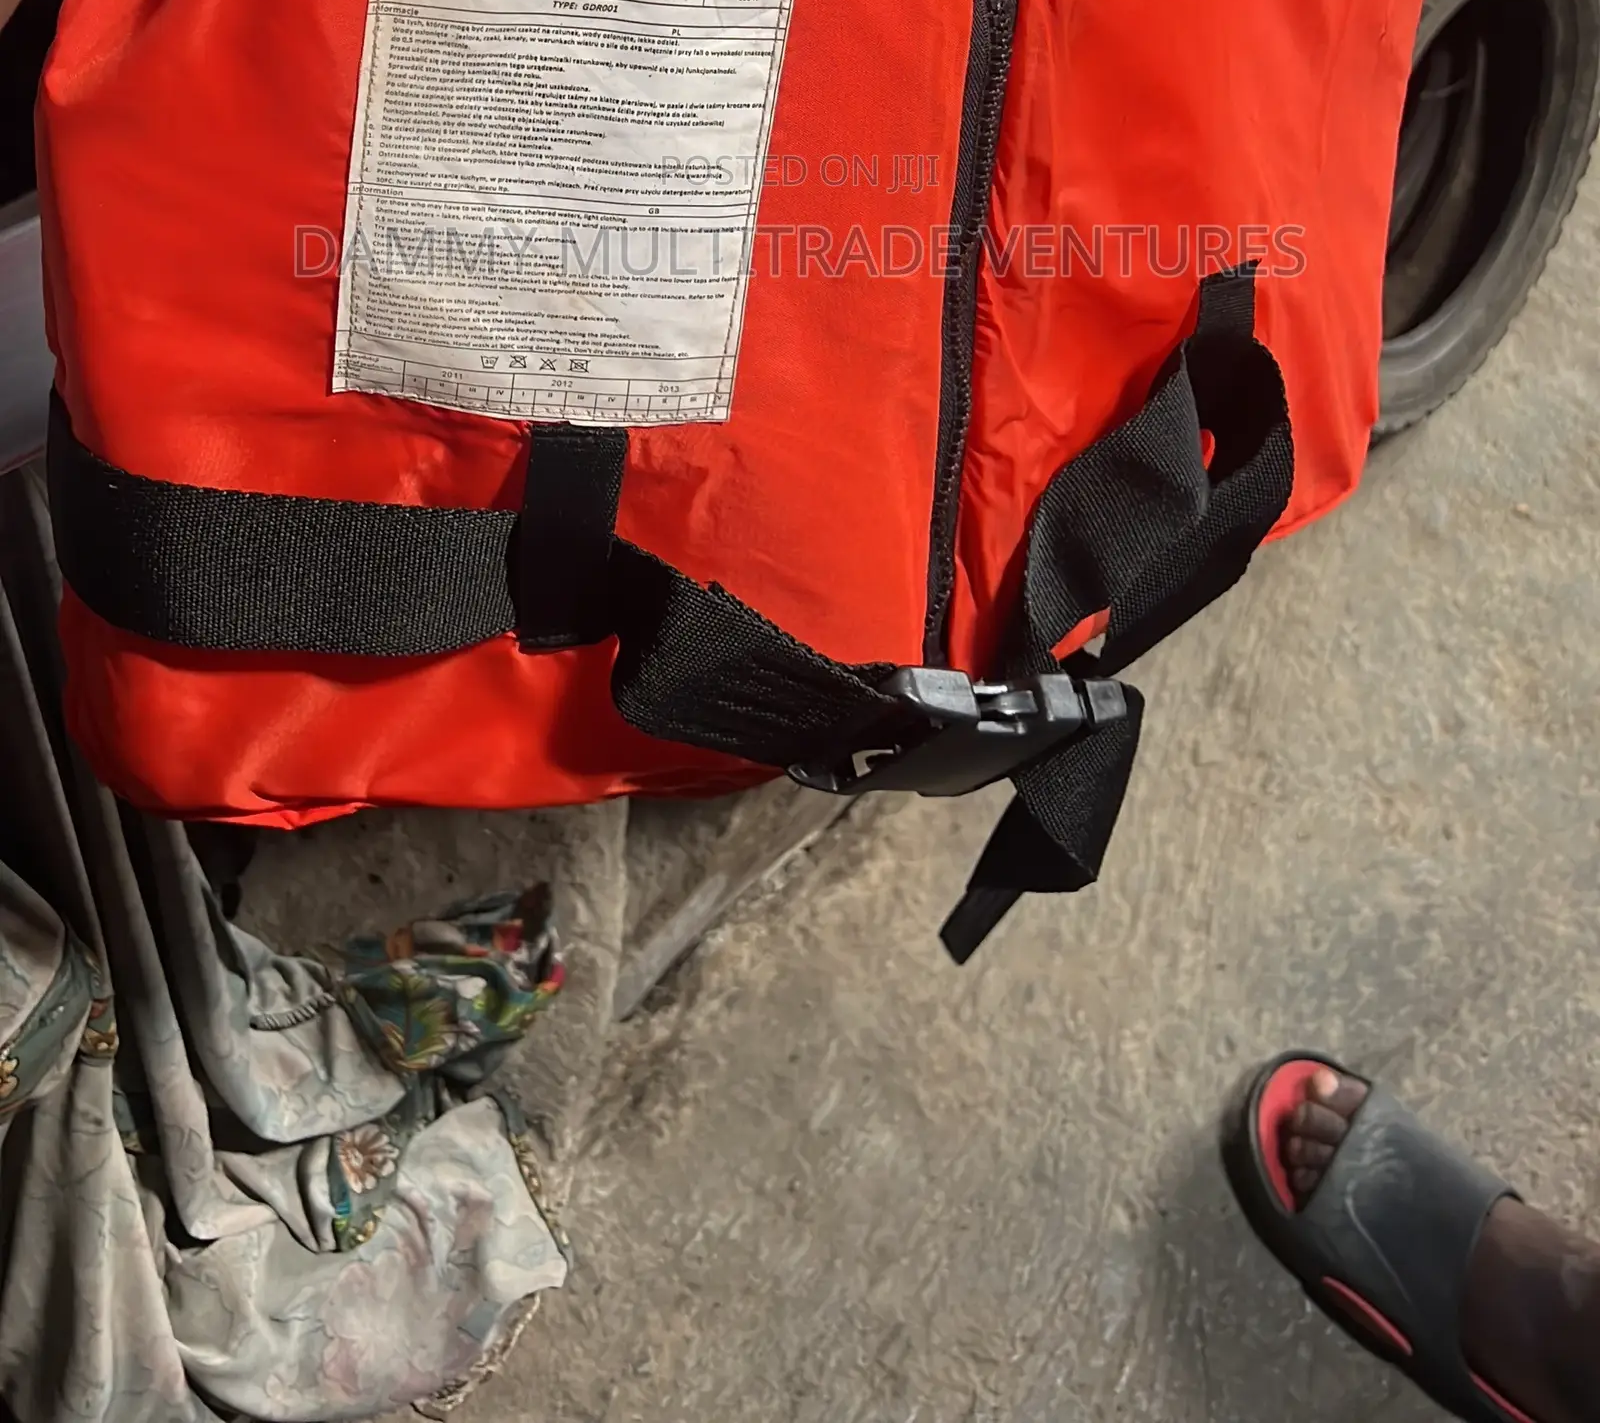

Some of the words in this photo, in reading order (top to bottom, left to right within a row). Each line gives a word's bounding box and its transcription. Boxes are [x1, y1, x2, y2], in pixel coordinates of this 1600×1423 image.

[552, 0, 578, 10] TYPE:
[582, 3, 619, 14] GDR001
[671, 28, 681, 36] PL
[441, 370, 463, 380] 2011
[550, 379, 574, 389] 2012
[658, 384, 680, 394] 2013
